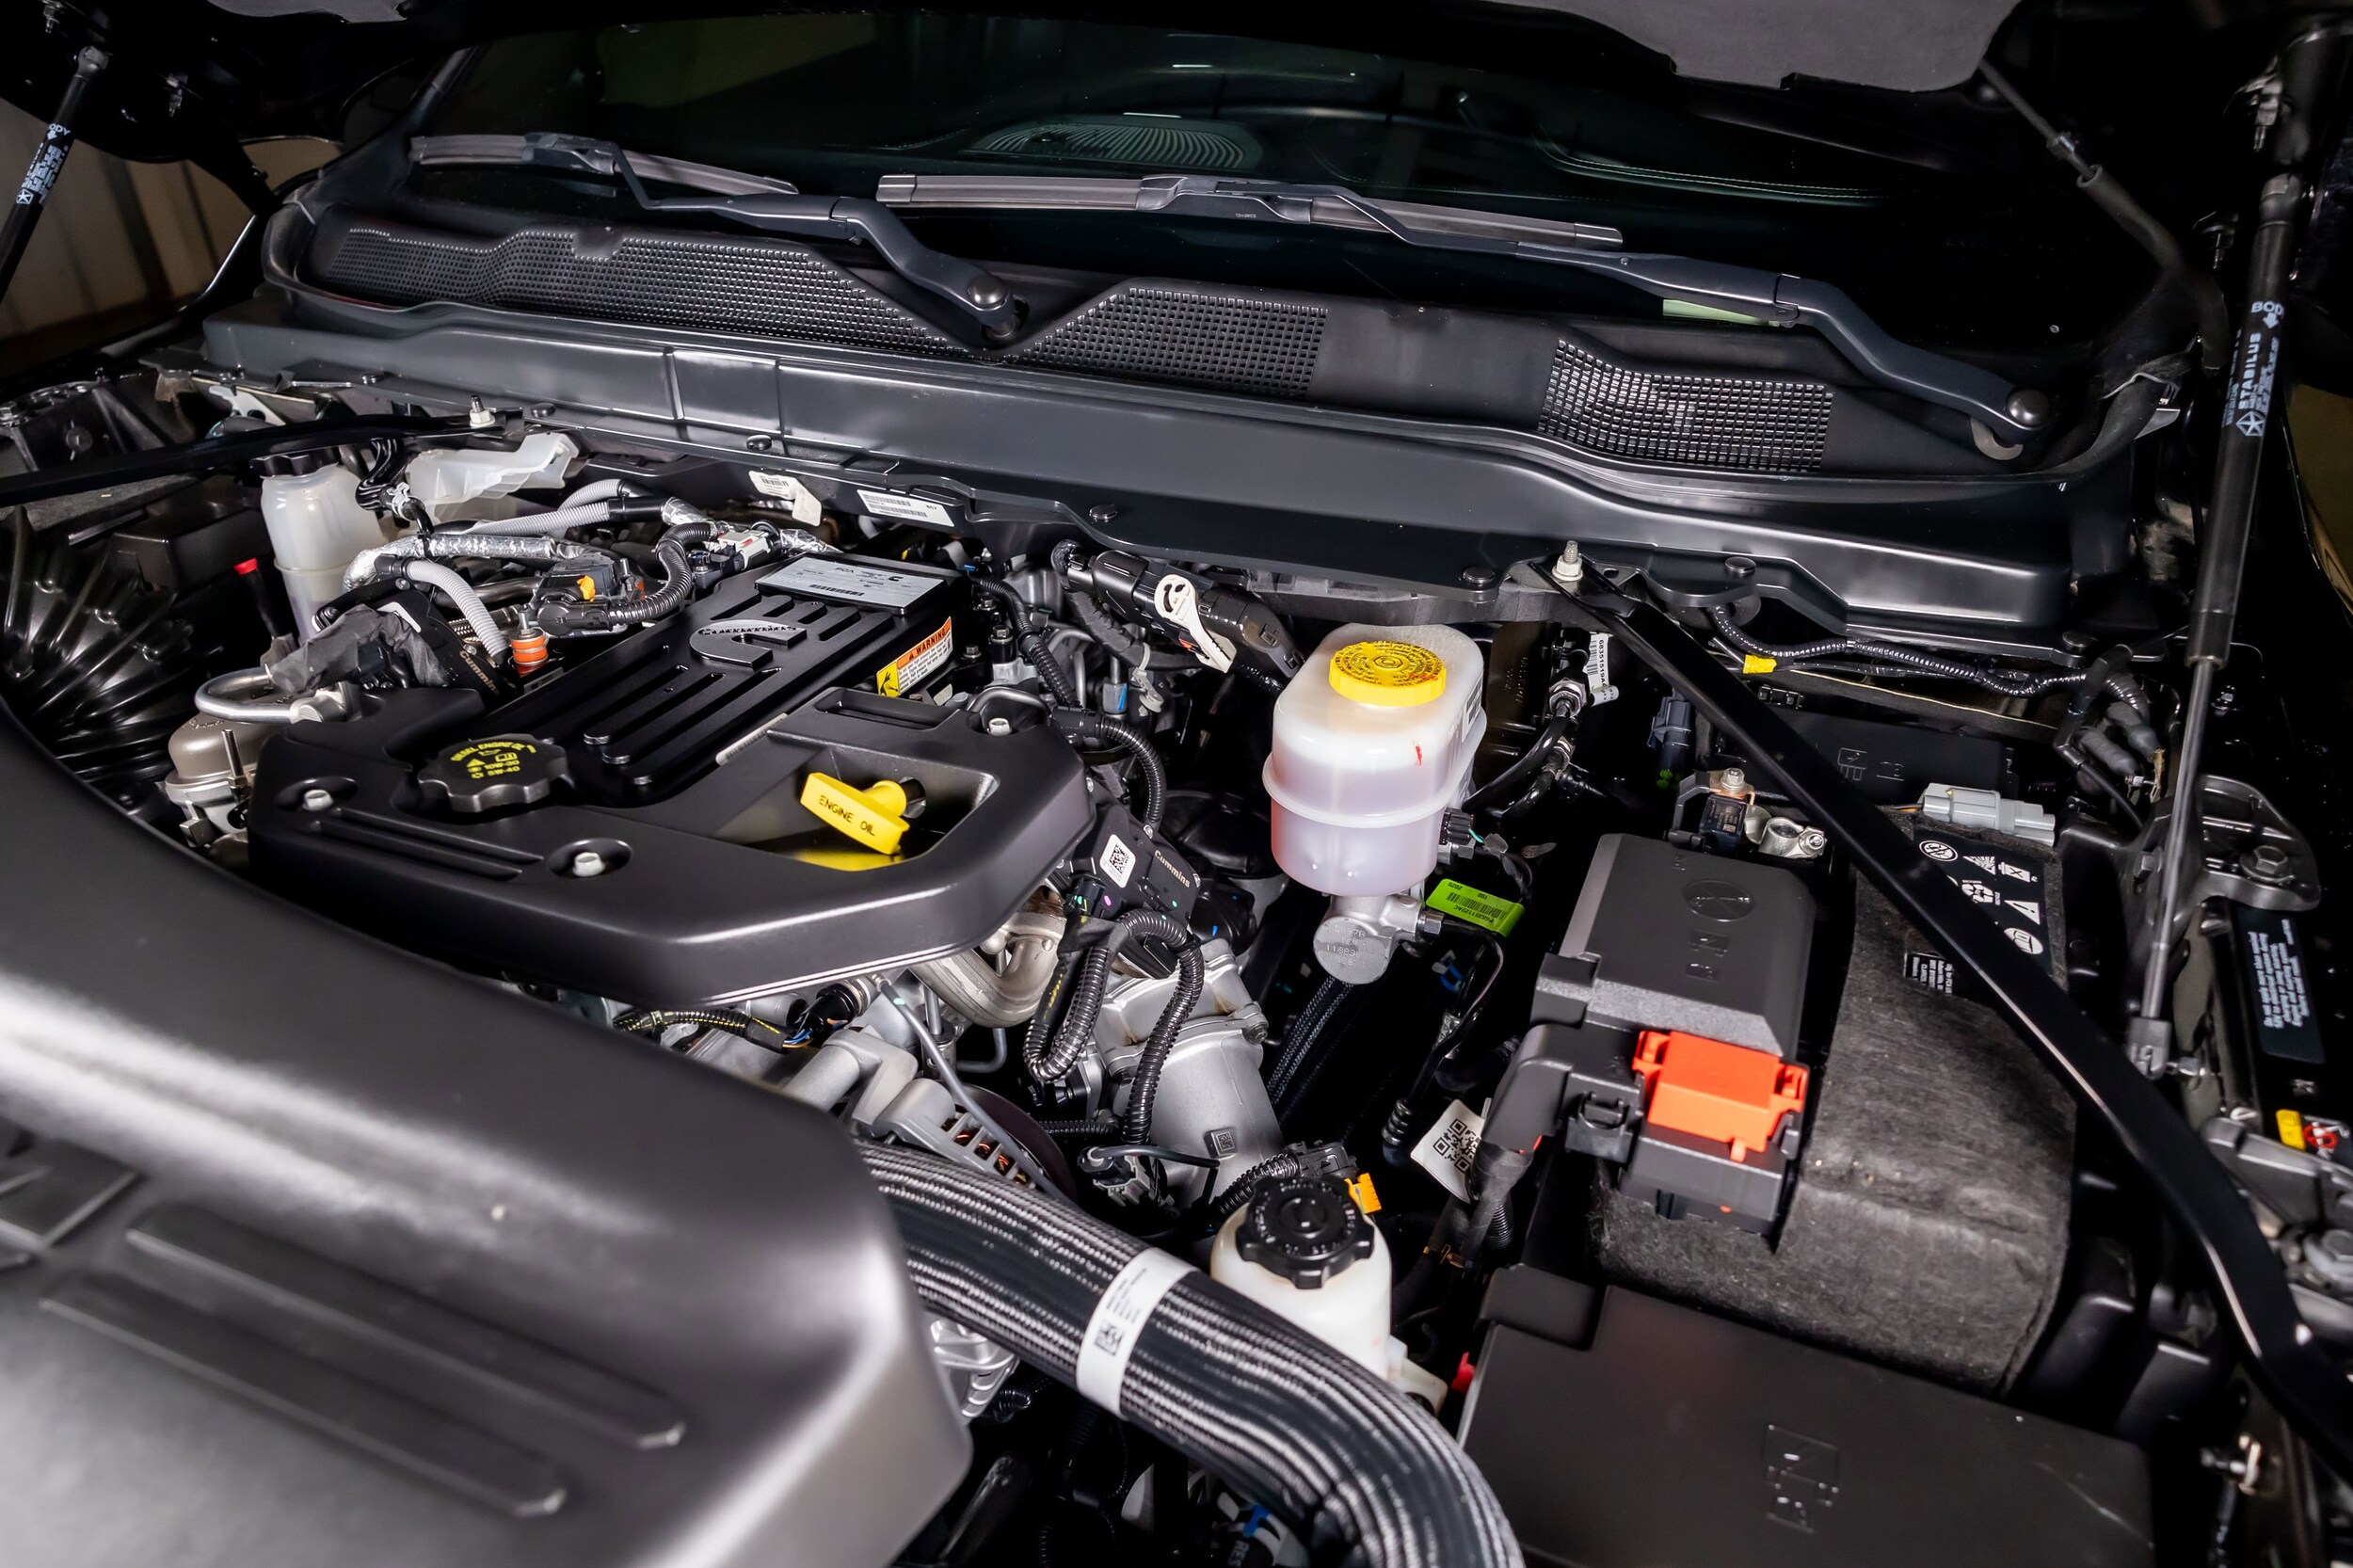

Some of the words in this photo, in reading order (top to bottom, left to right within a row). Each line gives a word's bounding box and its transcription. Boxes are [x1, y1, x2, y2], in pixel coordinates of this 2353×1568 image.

[47, 122, 72, 136] ODY
[2250, 300, 2285, 320] BOD
[2238, 332, 2262, 409] STABILUS
[915, 627, 946, 656] WARNING
[818, 794, 855, 824] ENGINE
[859, 820, 876, 837] OIL
[1154, 849, 1191, 888] Cummins
